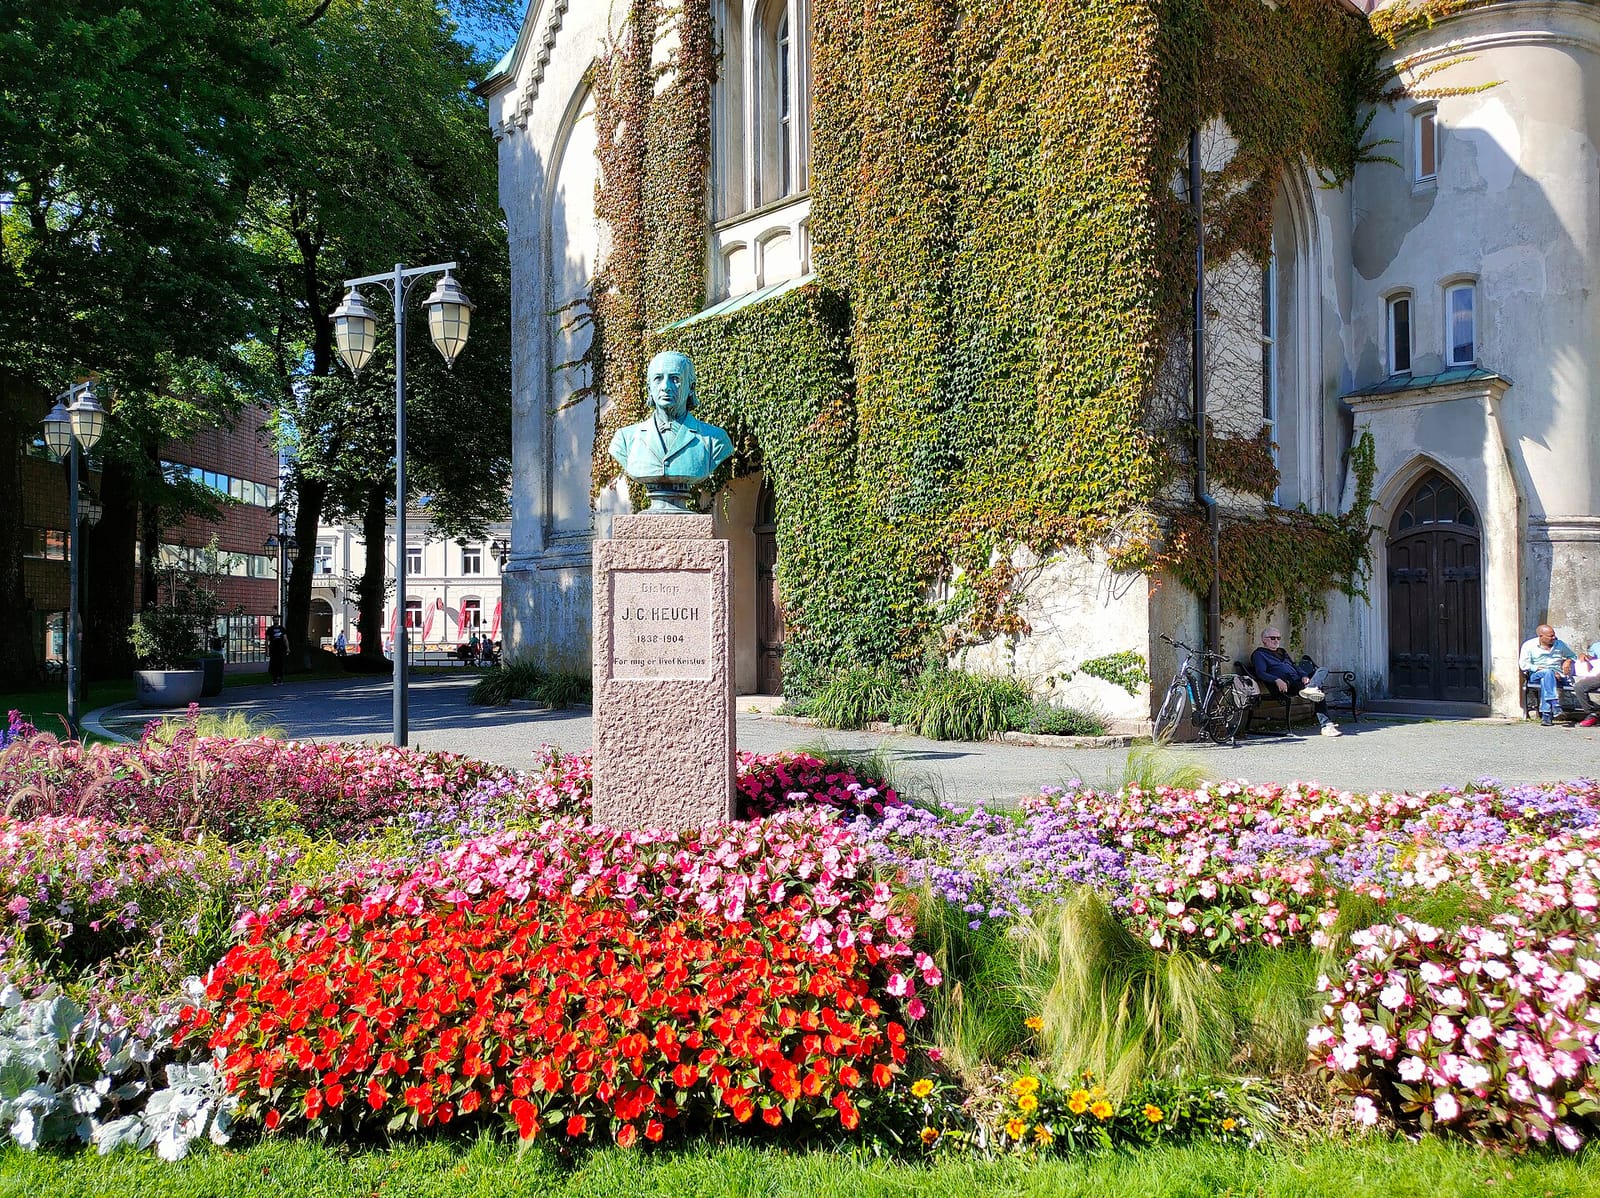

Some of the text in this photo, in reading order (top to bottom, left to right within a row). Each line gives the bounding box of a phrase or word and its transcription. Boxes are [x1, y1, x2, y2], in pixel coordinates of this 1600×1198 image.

[651, 607, 699, 621] HEUCH
[614, 657, 628, 665] For
[630, 657, 645, 668] mig
[659, 657, 675, 665] livet
